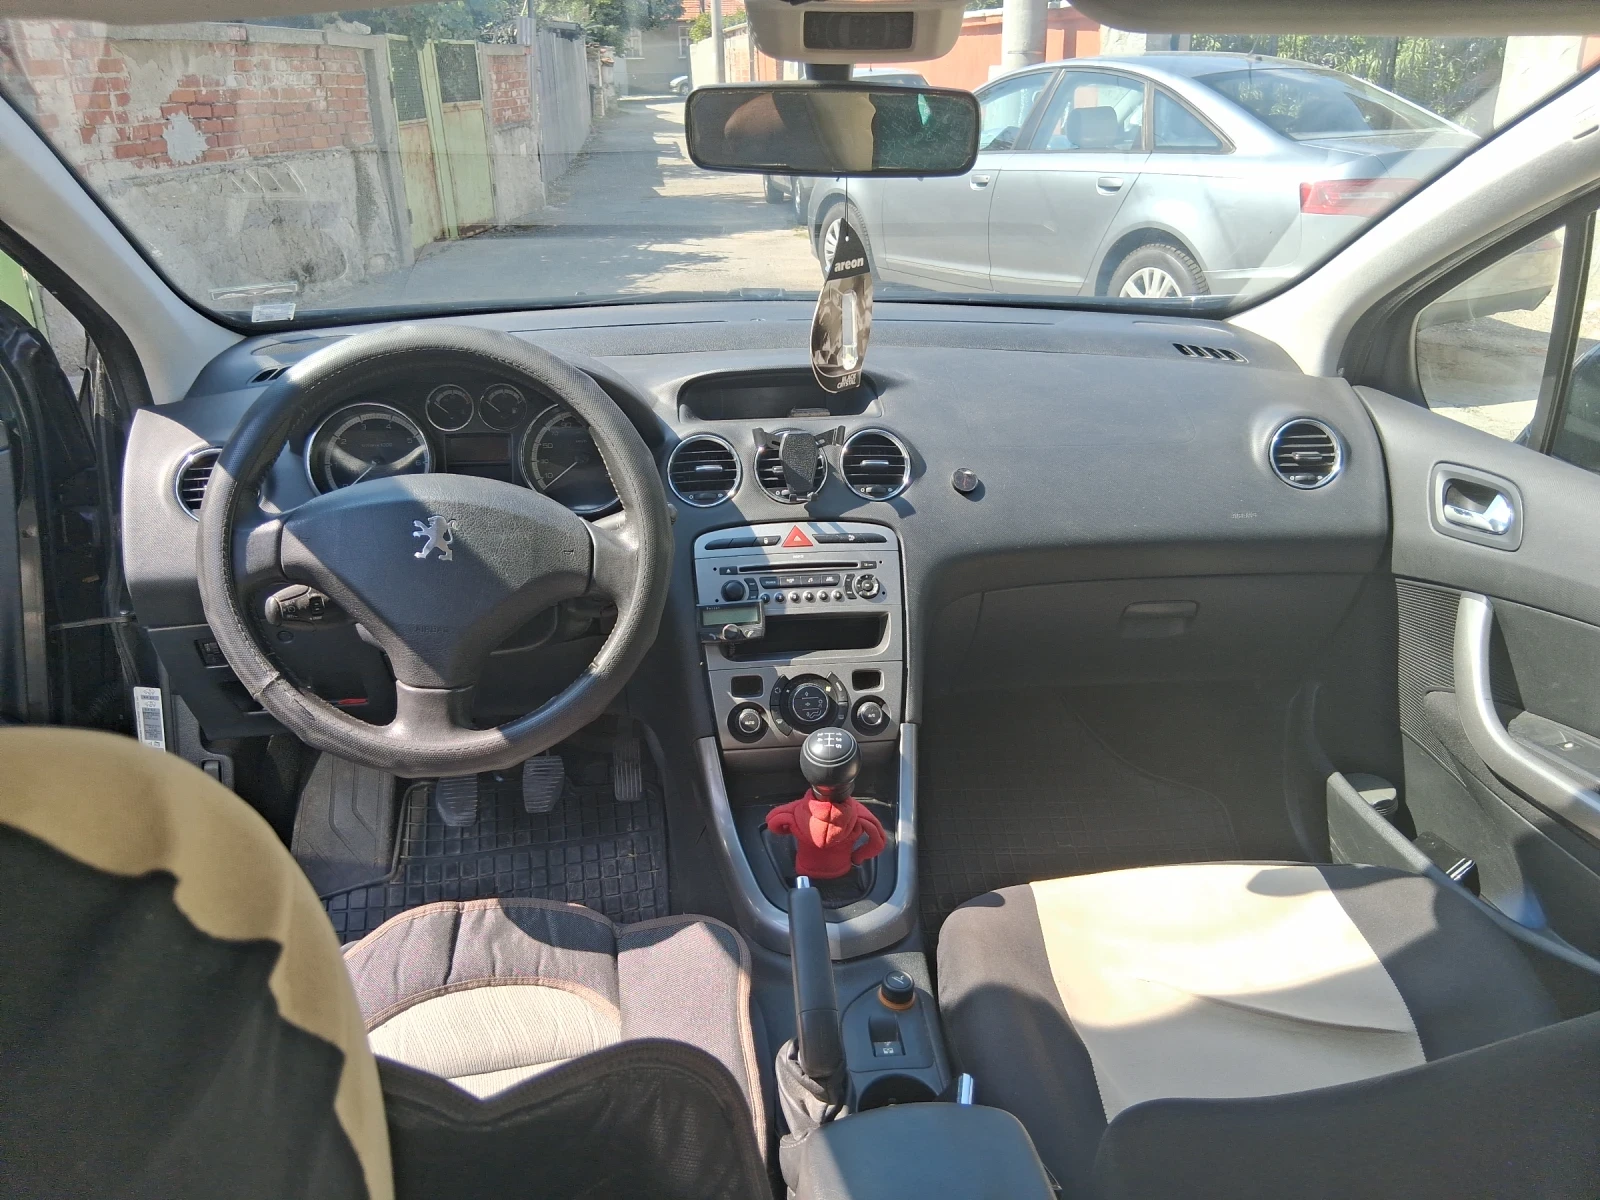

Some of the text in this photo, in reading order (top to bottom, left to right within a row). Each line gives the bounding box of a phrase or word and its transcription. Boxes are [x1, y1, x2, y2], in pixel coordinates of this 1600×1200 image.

[834, 257, 864, 272] areon
[841, 373, 857, 383] BLACK
[361, 423, 367, 431] 3
